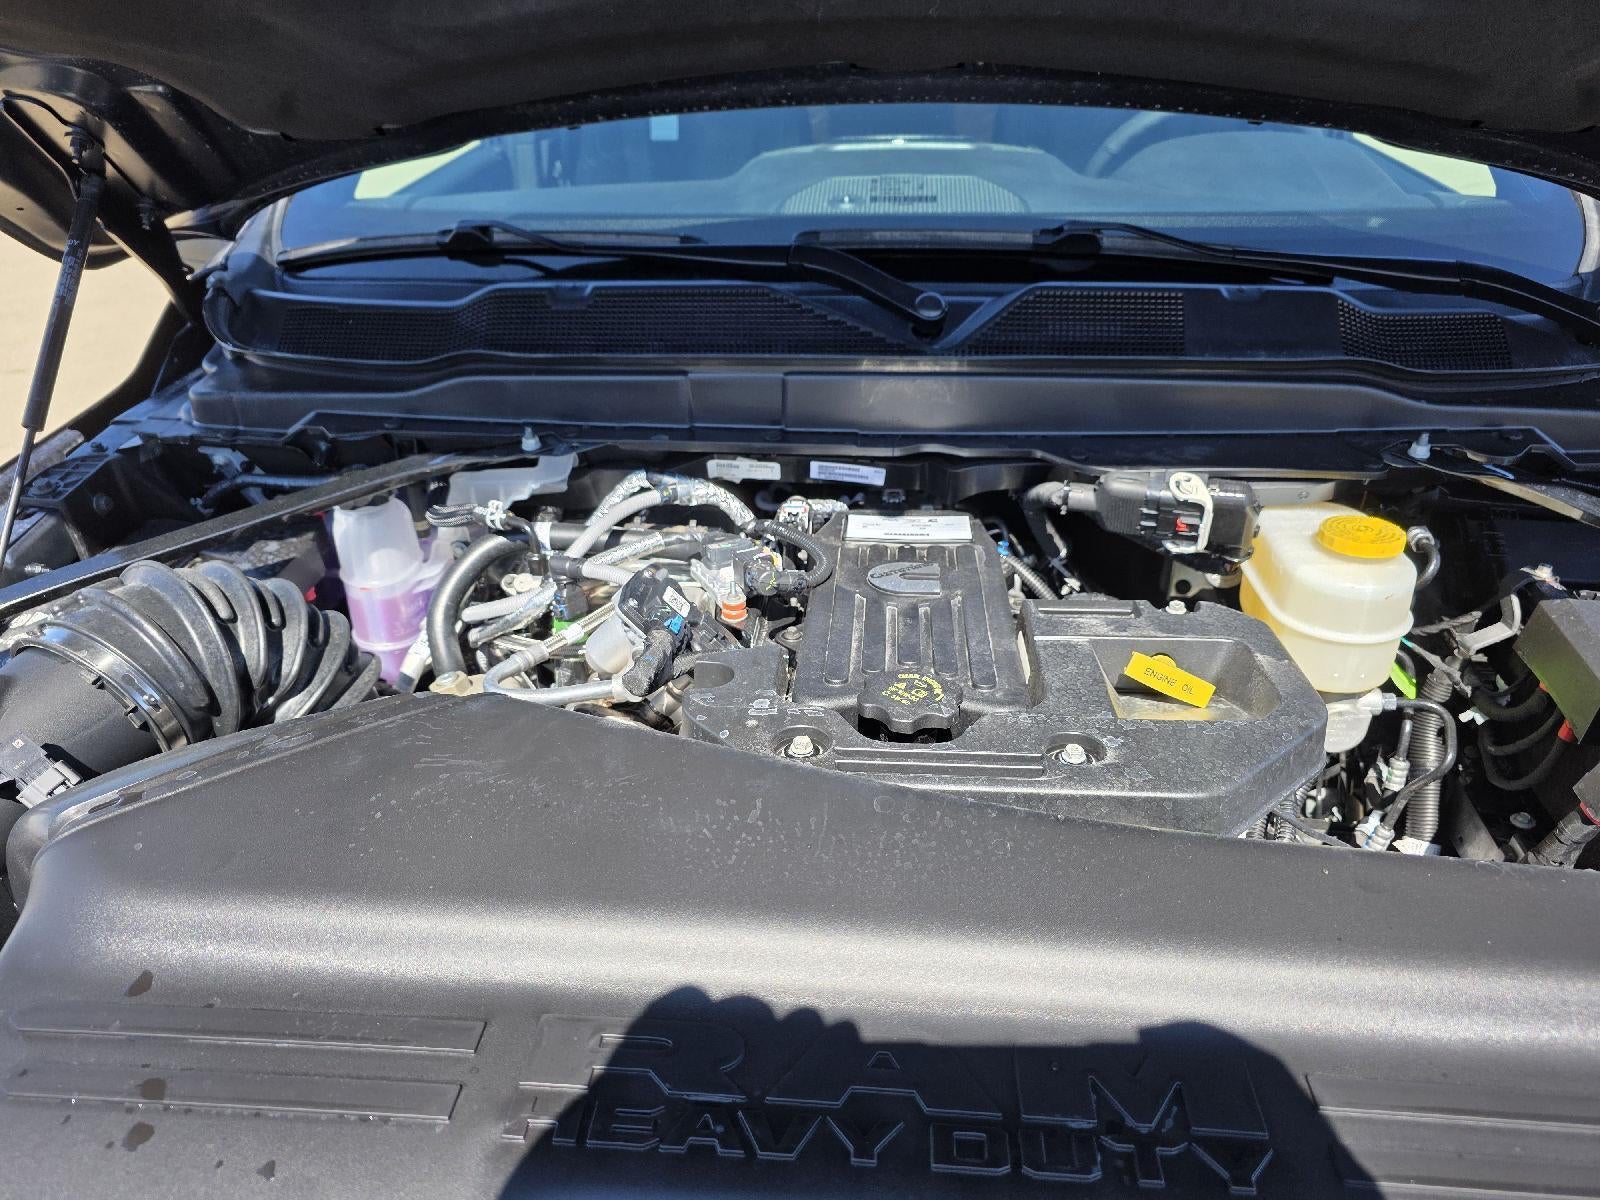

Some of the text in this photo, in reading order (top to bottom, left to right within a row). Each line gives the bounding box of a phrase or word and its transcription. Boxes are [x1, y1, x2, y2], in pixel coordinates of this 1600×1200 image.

[1143, 667, 1194, 695] ENGINE OIL
[518, 1015, 1270, 1139] RAM
[501, 1096, 1274, 1194] HEAVY DUTY
